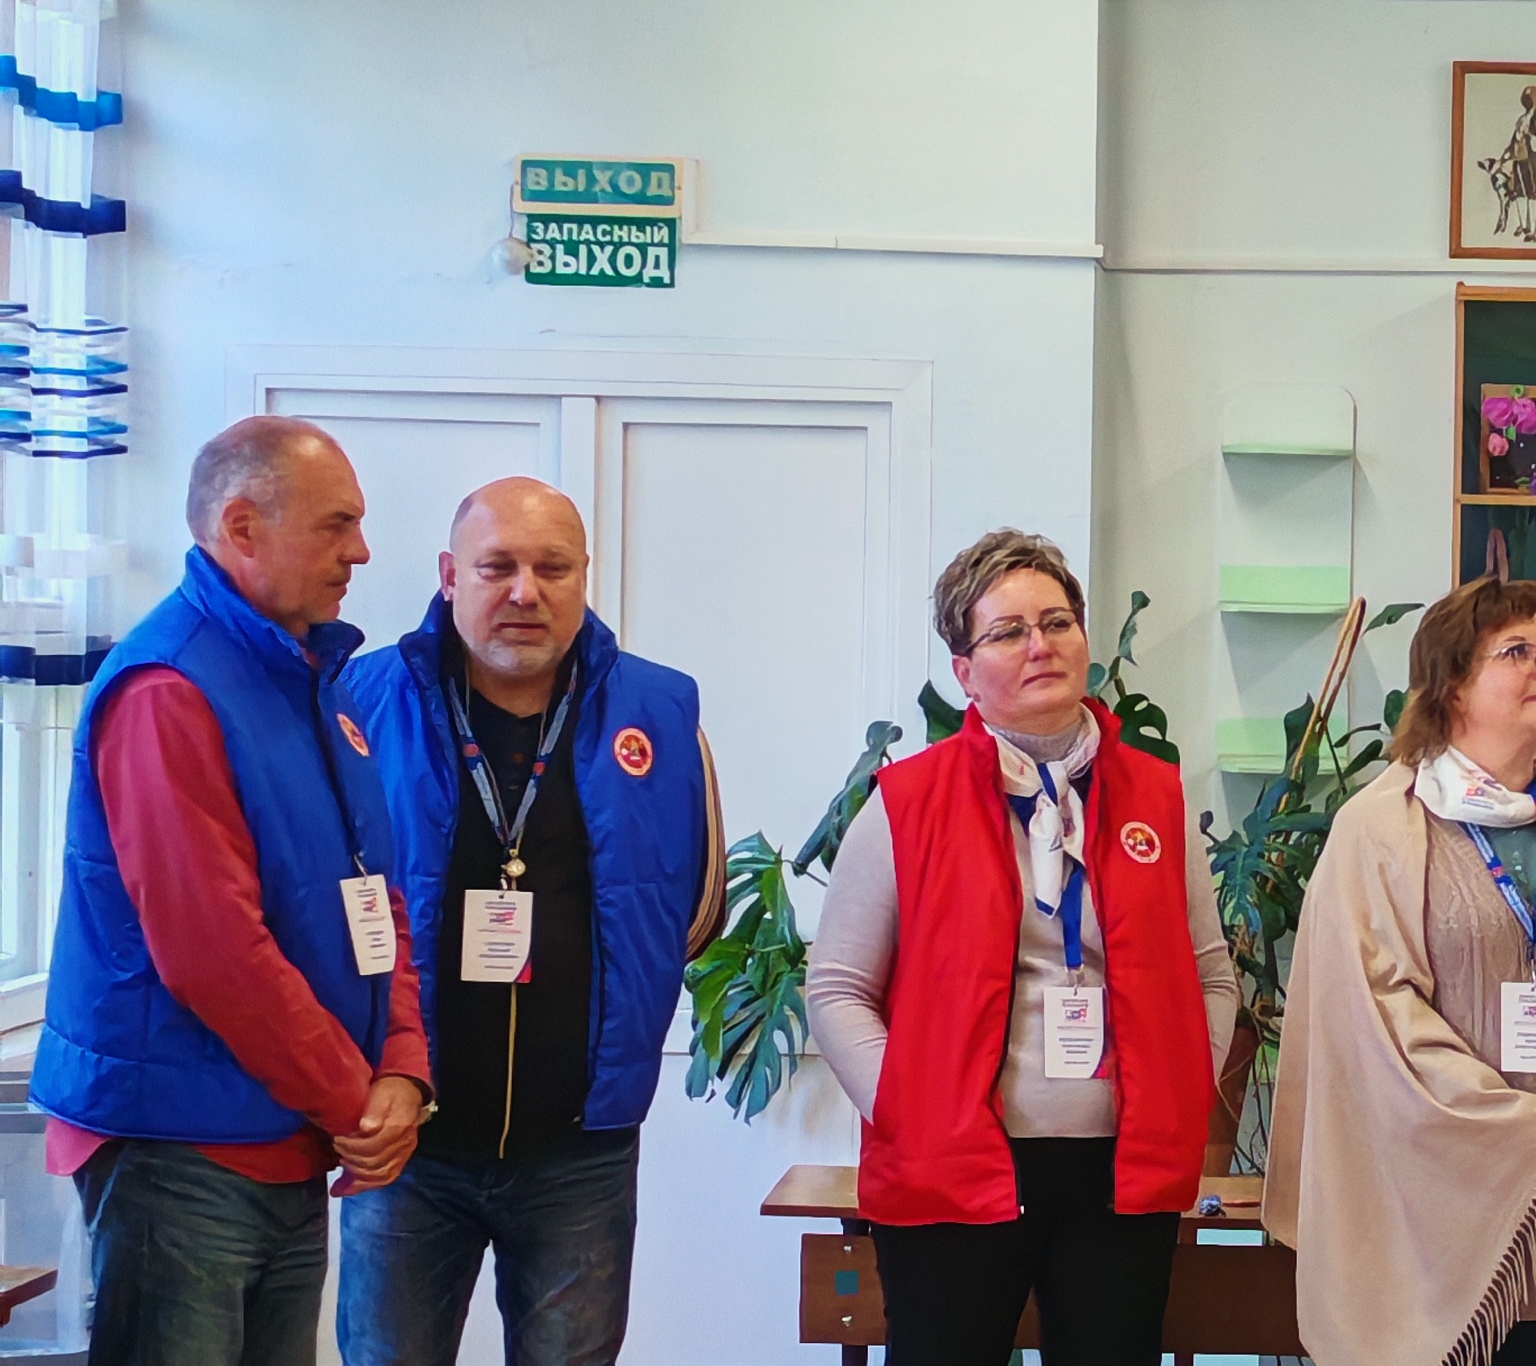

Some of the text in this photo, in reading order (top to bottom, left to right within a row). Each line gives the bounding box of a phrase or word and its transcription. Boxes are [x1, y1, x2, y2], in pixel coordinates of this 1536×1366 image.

[526, 167, 673, 196] ВЫХОД
[529, 222, 669, 243] ЗАПАСНЫЙ
[528, 243, 671, 284] ВЫХОД
